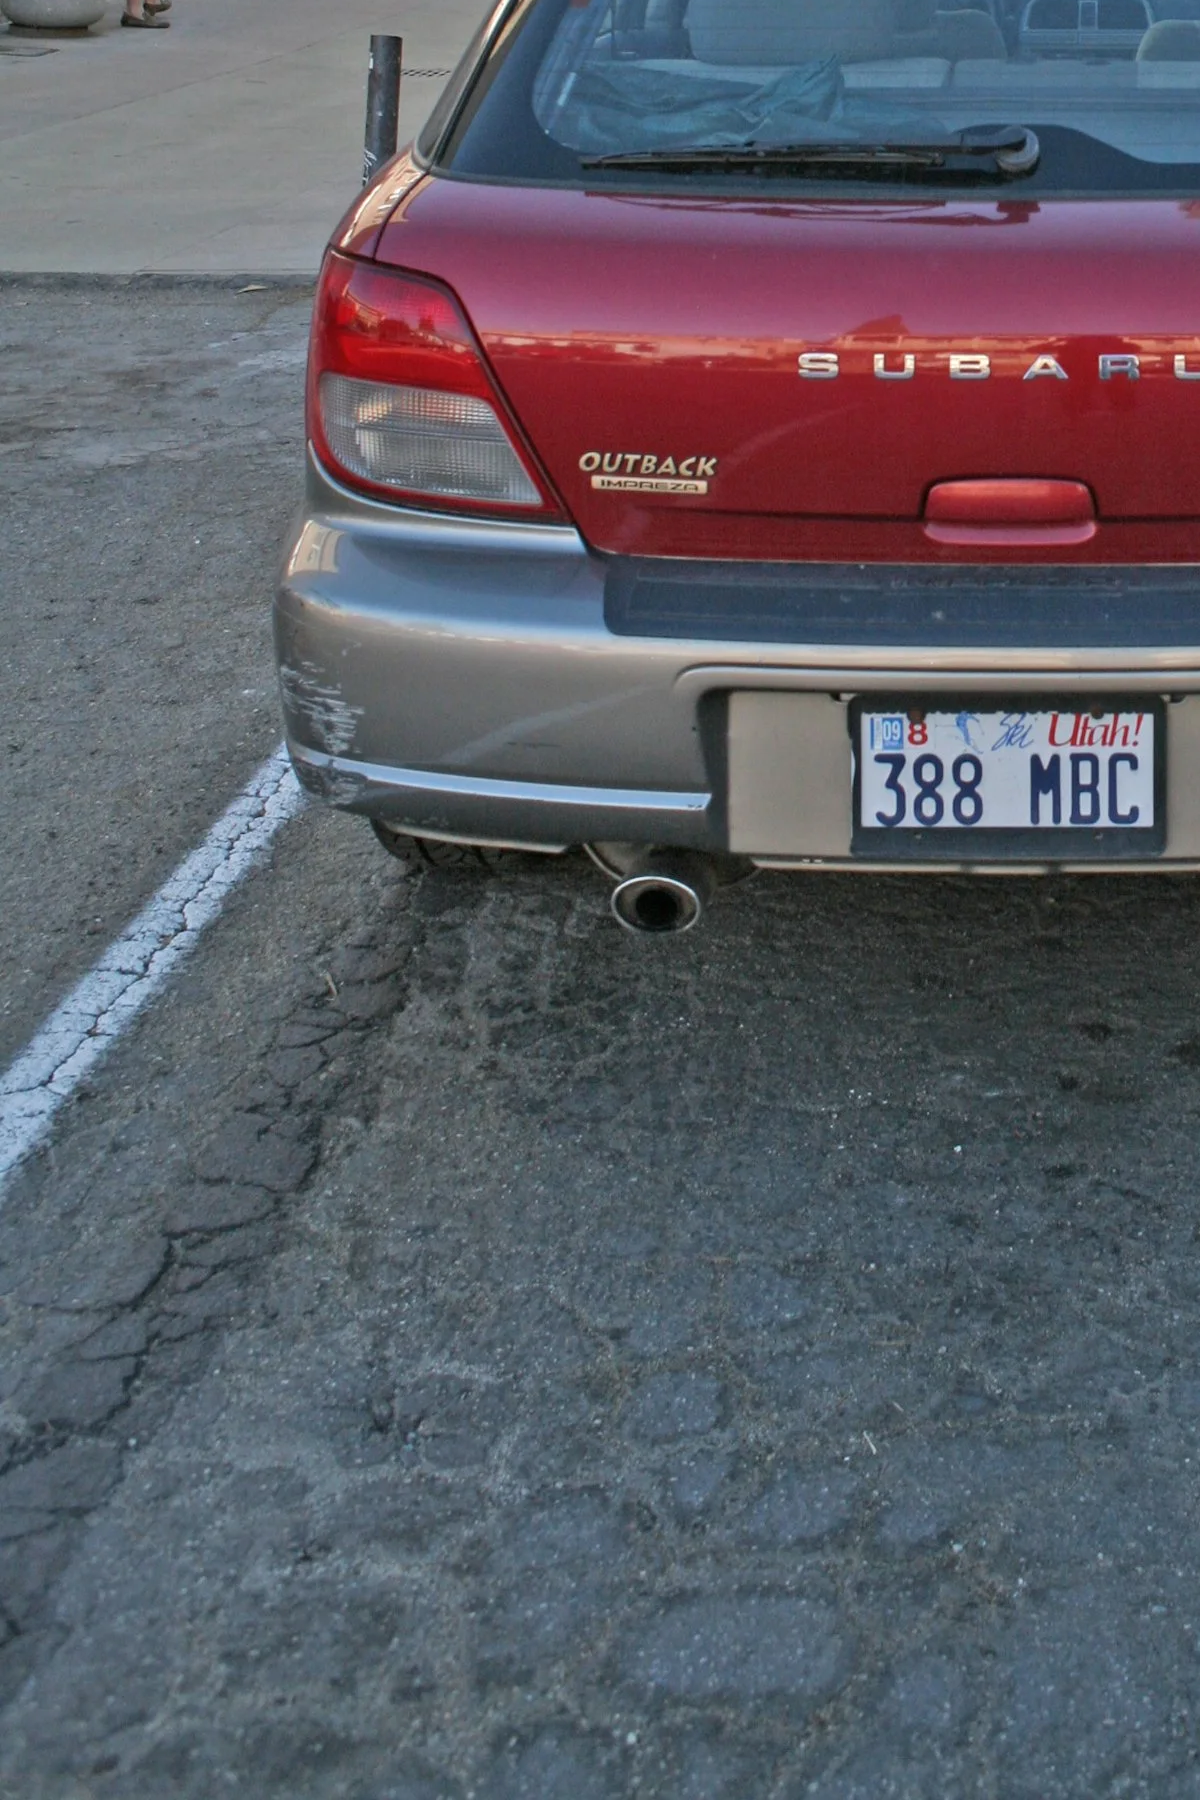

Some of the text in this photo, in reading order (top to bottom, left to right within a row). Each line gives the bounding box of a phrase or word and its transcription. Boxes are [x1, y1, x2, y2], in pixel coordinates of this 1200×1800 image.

[578, 451, 718, 477] OUTBACK
[599, 478, 699, 492] IMPREZA
[883, 720, 901, 741] 09
[991, 711, 1144, 751] Ski Utah!
[873, 752, 1140, 827] 388 MBC
